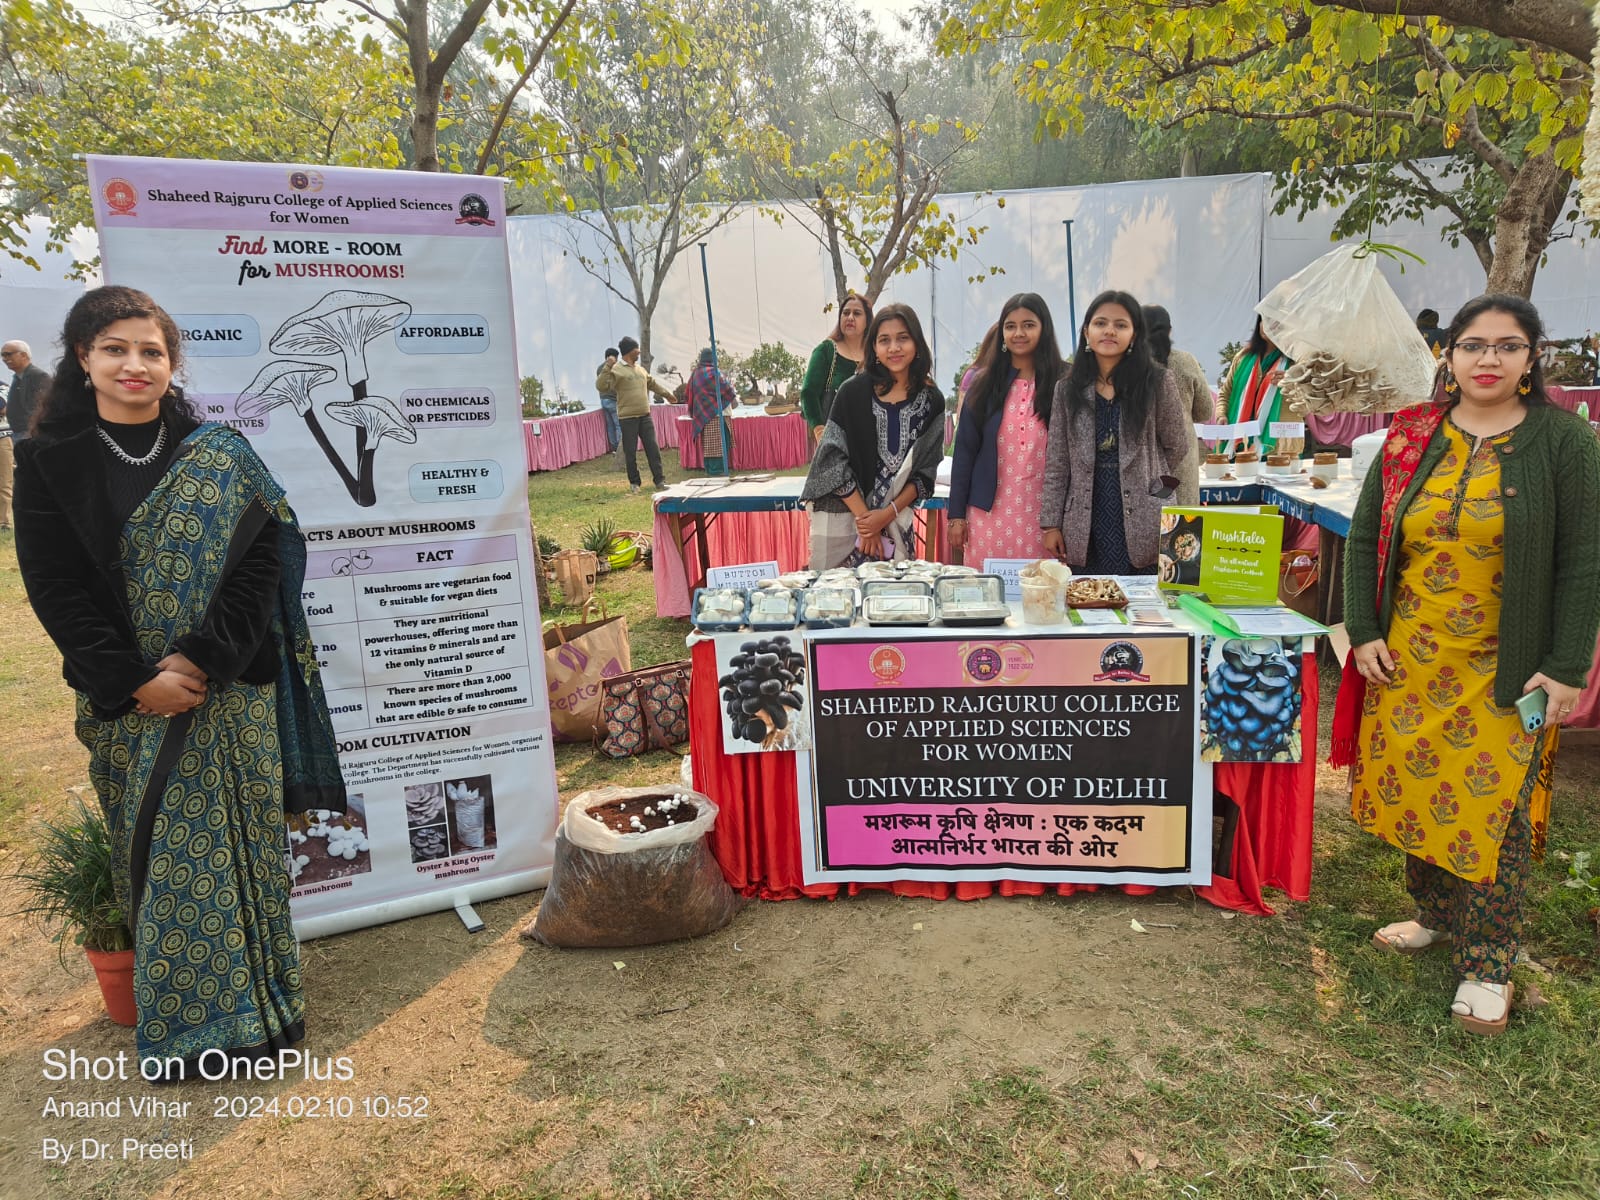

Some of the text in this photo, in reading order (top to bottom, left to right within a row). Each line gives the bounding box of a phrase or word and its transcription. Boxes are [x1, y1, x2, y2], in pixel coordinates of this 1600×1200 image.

[147, 189, 211, 204] Shaheed
[214, 192, 270, 208] Rajguru
[273, 193, 325, 209] College
[328, 195, 342, 207] of
[345, 196, 397, 212] Applied
[399, 197, 453, 212] Sciences
[270, 211, 350, 225] for Women
[218, 235, 268, 255] Find
[273, 240, 329, 255] MORE
[347, 241, 402, 256] ROOM
[238, 260, 405, 285] for MUSHROOMS!
[181, 329, 242, 341] RGANIC
[399, 326, 485, 338] AFFORDABLE
[207, 405, 224, 414] NO
[406, 396, 490, 407] NO CHEMICALS
[408, 412, 490, 423] OR PESTICIDES
[422, 468, 489, 481] HEALTHY &
[438, 484, 476, 496] FRESH
[302, 520, 476, 542] CTS ABOUT MUSHROOMS
[1212, 529, 1265, 545] MushTales
[416, 549, 454, 563] FACT
[724, 569, 766, 579] BUTTON
[992, 568, 1018, 577] PEARL
[364, 572, 512, 595] Mushrooms are vegetarian food
[717, 580, 759, 589] MUSHRO
[301, 590, 315, 599] re
[379, 586, 498, 607] & suitable for vegan diets
[307, 604, 334, 616] food
[393, 609, 489, 630] They are nutritional
[364, 618, 518, 646] powerhouses, offering more than
[322, 643, 337, 652] no
[370, 632, 516, 658] 12 vitamins & minerals and are
[385, 646, 505, 670] the only natural source of
[423, 664, 473, 679] Vitamin D
[387, 672, 512, 696] There are more than 2,000
[383, 685, 518, 710] known species of mushrooms
[820, 693, 1180, 716] SHAHEED RAJGURU COLLEGE
[327, 703, 362, 715] onous
[375, 714, 396, 724] that
[398, 713, 414, 722] are
[416, 709, 446, 719] edible
[447, 707, 455, 716] &
[457, 704, 476, 714] safe
[488, 696, 528, 709] consume
[371, 726, 471, 748] CULTIVATION
[866, 718, 1131, 739] OF APPLIED SCIENCES
[348, 760, 377, 770] Rajguru
[377, 755, 404, 765] College
[414, 750, 441, 761] Applied
[442, 747, 471, 756] Sciences
[372, 766, 386, 774] The
[387, 761, 429, 772] Department
[430, 757, 442, 766] has
[443, 753, 482, 764] successfully
[483, 746, 515, 759] cultivated
[516, 744, 540, 752] various
[922, 743, 1073, 762] FOR WOMEN
[351, 775, 393, 786] mushrooms
[846, 776, 1168, 800] UNIVERSITY OF DELHI
[863, 807, 1145, 835] मशरूम कृषि क्षेत्रण : एक कदम
[891, 833, 1119, 858] आत्मनिर्भर भारत की ओर
[416, 862, 443, 873] Oyster
[451, 858, 469, 869] King
[470, 853, 496, 864] Oyster
[434, 866, 480, 880] mushrooms
[304, 880, 353, 896] mushrooms
